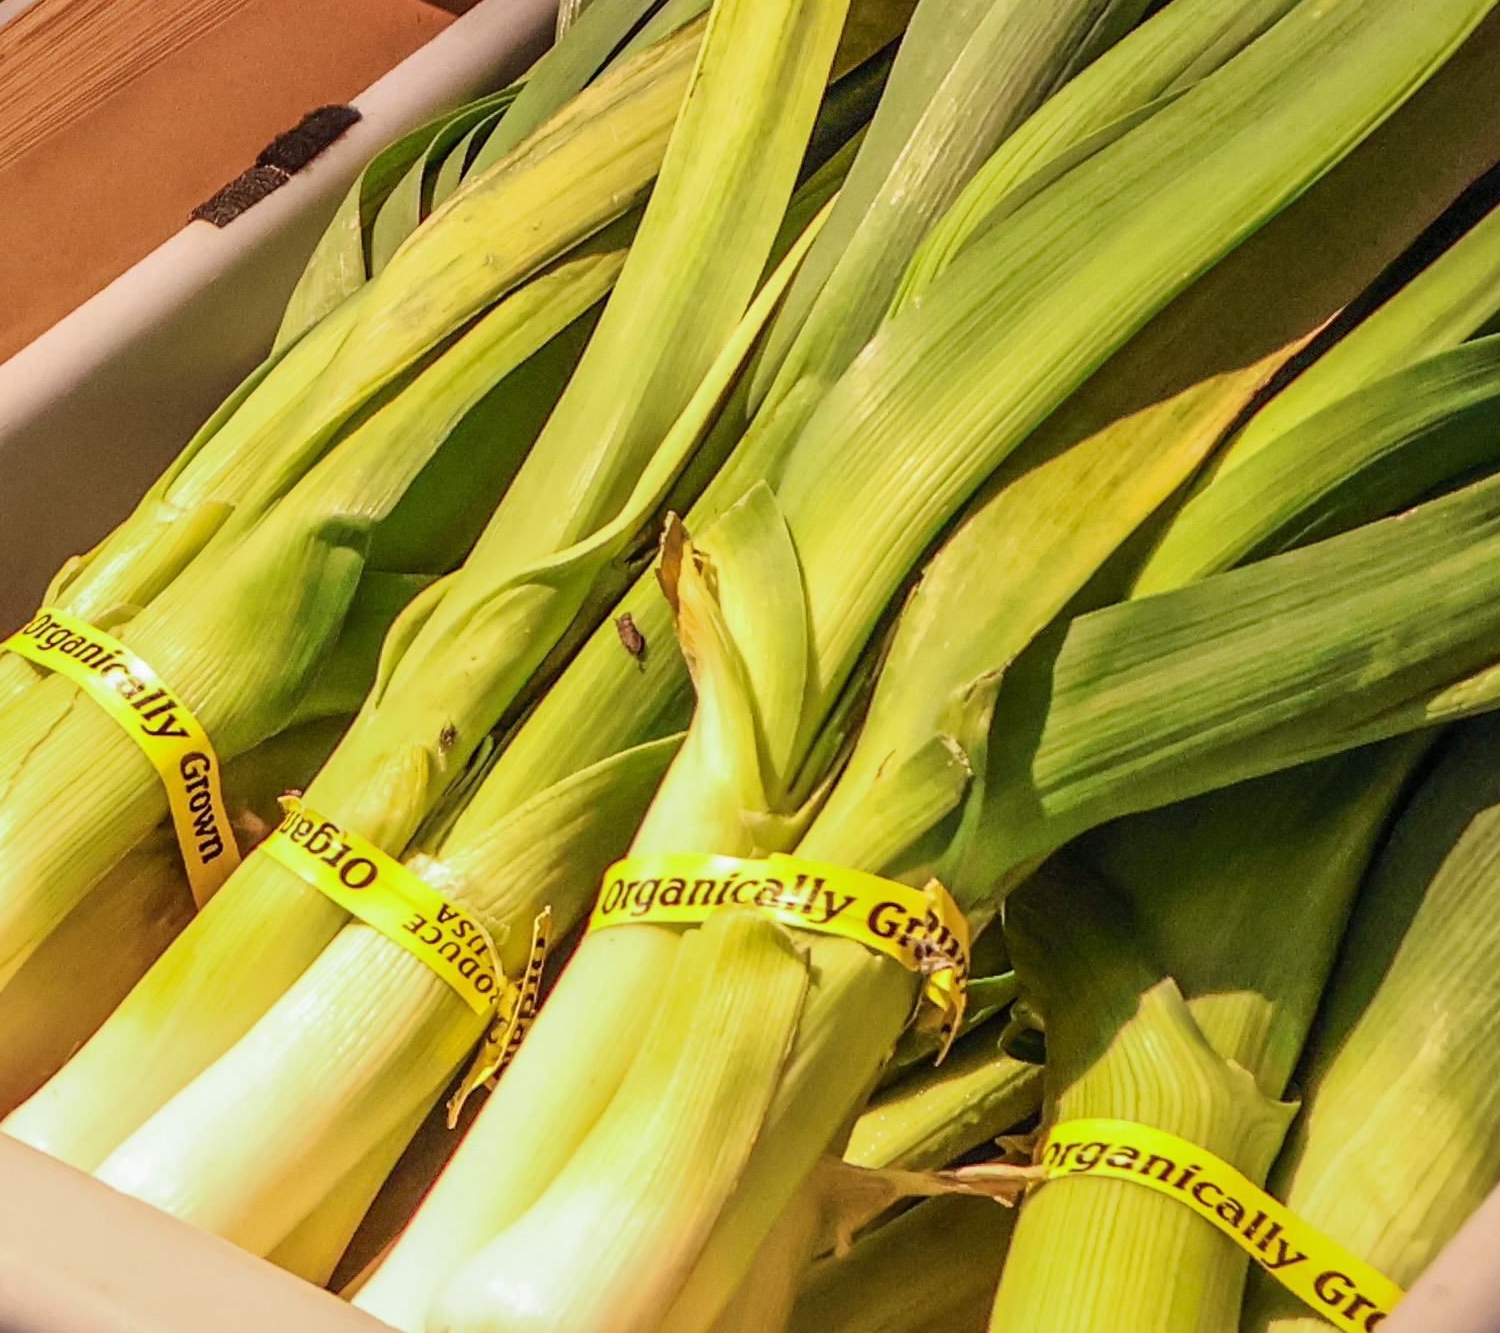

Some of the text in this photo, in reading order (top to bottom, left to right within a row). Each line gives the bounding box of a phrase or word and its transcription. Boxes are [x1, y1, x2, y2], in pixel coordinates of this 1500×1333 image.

[21, 613, 225, 865] Organically Grown
[435, 902, 492, 959] USA
[600, 871, 858, 925] Organically
[1041, 1141, 1309, 1270] Organically
